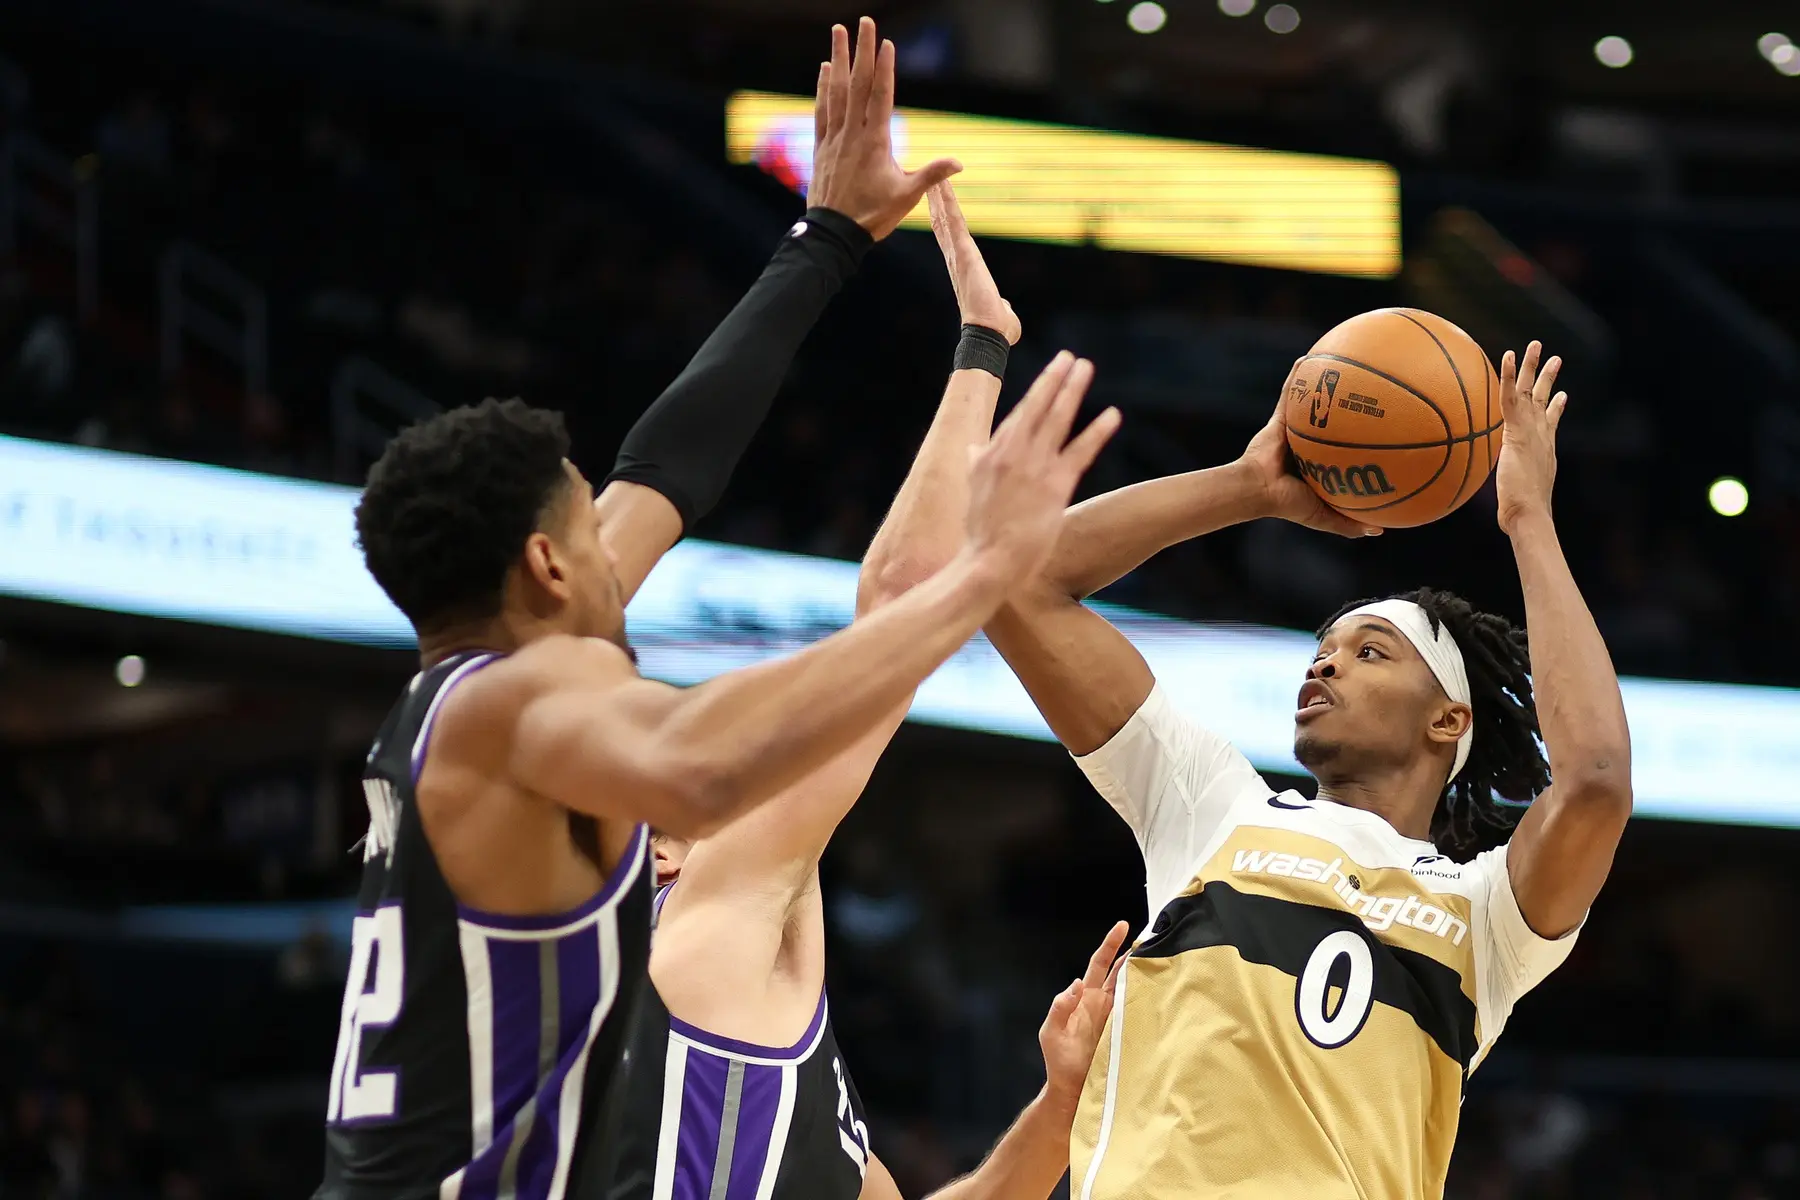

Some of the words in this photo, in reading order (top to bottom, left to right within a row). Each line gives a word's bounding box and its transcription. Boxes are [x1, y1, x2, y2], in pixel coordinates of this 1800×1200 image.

[1293, 453, 1396, 497] Wilso
[1230, 849, 1468, 947] washington
[1294, 926, 1375, 1050] 0
